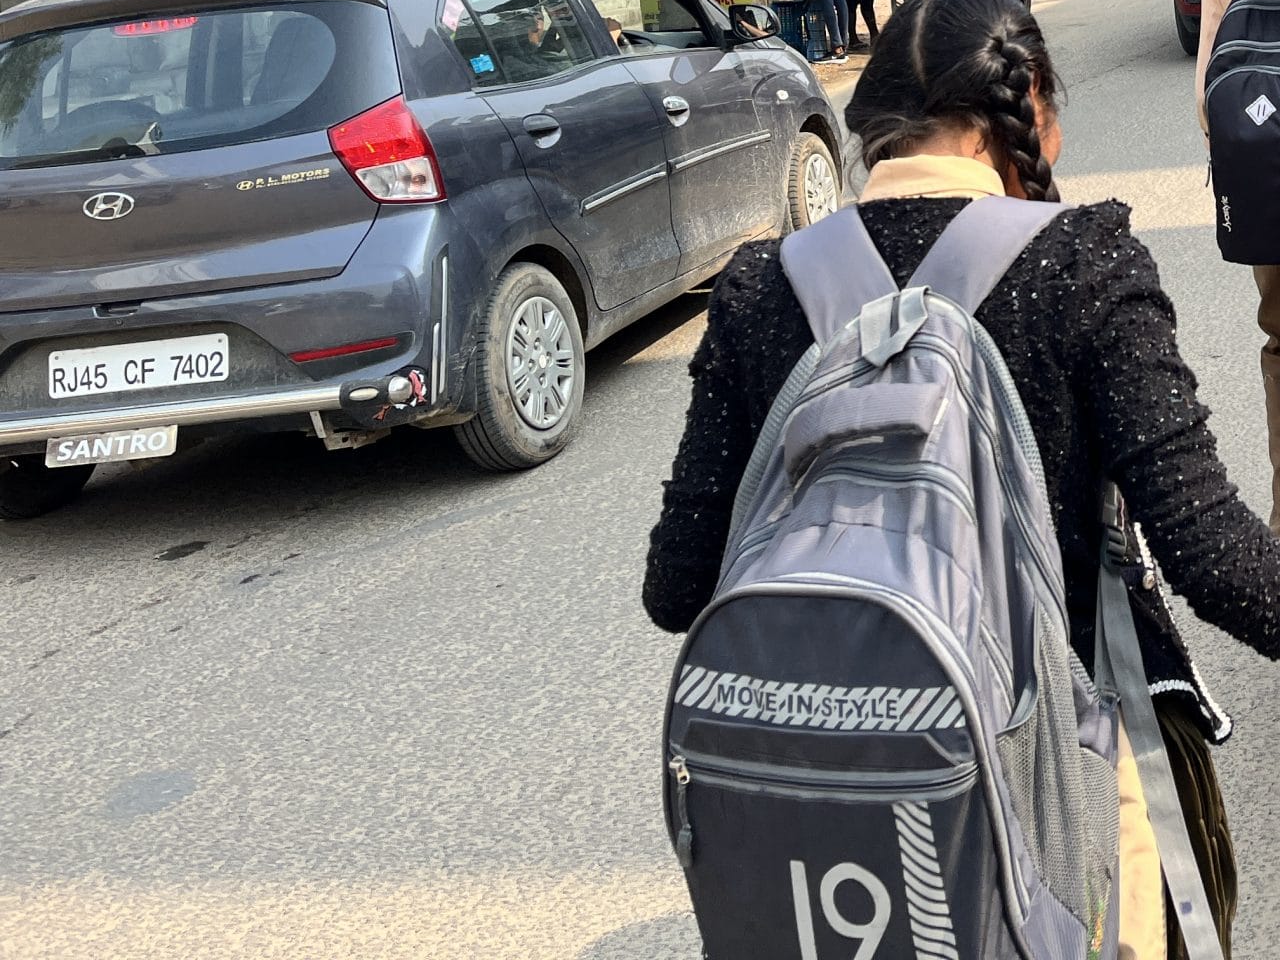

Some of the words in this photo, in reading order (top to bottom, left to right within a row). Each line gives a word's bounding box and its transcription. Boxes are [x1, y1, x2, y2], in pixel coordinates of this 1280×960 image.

[281, 168, 330, 181] MOTORS
[53, 364, 108, 393] RJ45
[124, 358, 155, 385] CF
[170, 351, 224, 381] 7402
[57, 431, 167, 462] SANTRO
[717, 683, 776, 713] MOVE
[787, 694, 812, 716] IN
[822, 697, 898, 720] STYLE
[790, 859, 891, 960] 19
